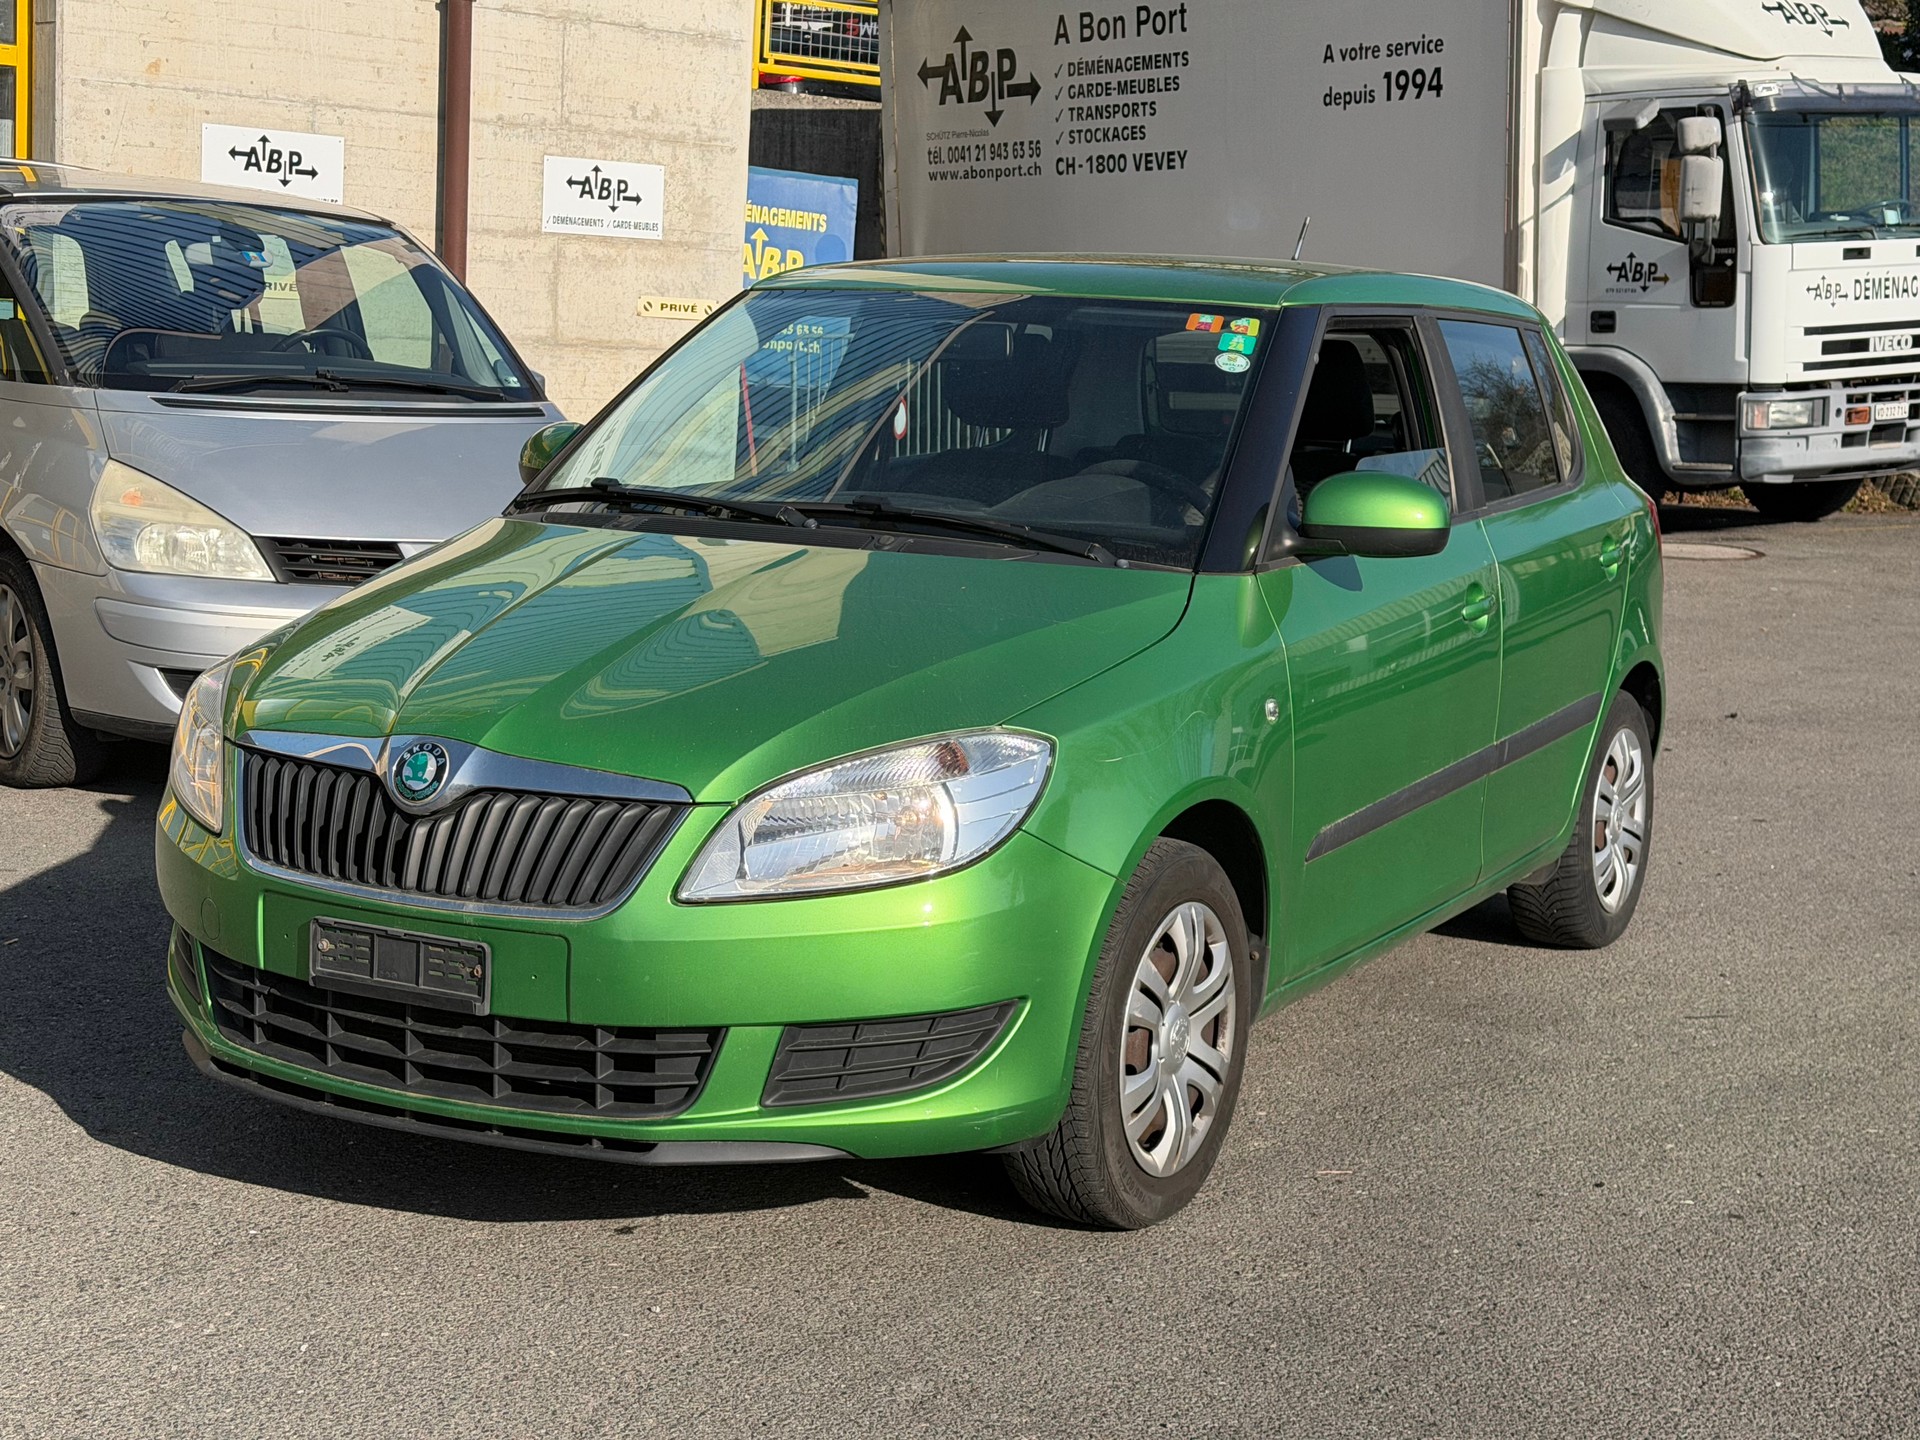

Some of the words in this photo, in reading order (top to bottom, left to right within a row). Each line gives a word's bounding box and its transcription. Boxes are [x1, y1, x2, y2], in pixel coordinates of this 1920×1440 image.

[1054, 14, 1070, 46] A
[1079, 11, 1126, 43] Bon
[1136, 2, 1187, 38] Port
[1322, 43, 1335, 64] A
[1339, 42, 1381, 62] votre
[1386, 33, 1444, 58] service
[1067, 51, 1189, 77] DÉMÉNAGEMENTS
[1068, 75, 1180, 100] GARDE-MEUBLES
[1323, 83, 1376, 111] depuis
[1382, 66, 1443, 102] 1994
[1068, 100, 1157, 122] TRANSPORTS
[1068, 124, 1147, 145] STOCKAGES
[243, 146, 303, 175] ABP
[927, 145, 945, 165] tél.
[948, 145, 971, 164] 0041
[975, 143, 987, 162] 21
[990, 141, 1009, 160] 943
[1012, 140, 1026, 159] 63
[1028, 139, 1042, 159] 56
[1132, 149, 1188, 172] VEVEY
[928, 161, 1042, 181] www.abonport.ch
[578, 175, 629, 202] ABP
[552, 213, 604, 228] DÉMÉNAGEMENTS
[1616, 261, 1659, 283] ABP
[660, 302, 698, 313] PRIVÉ
[1868, 334, 1913, 353] IVECO
